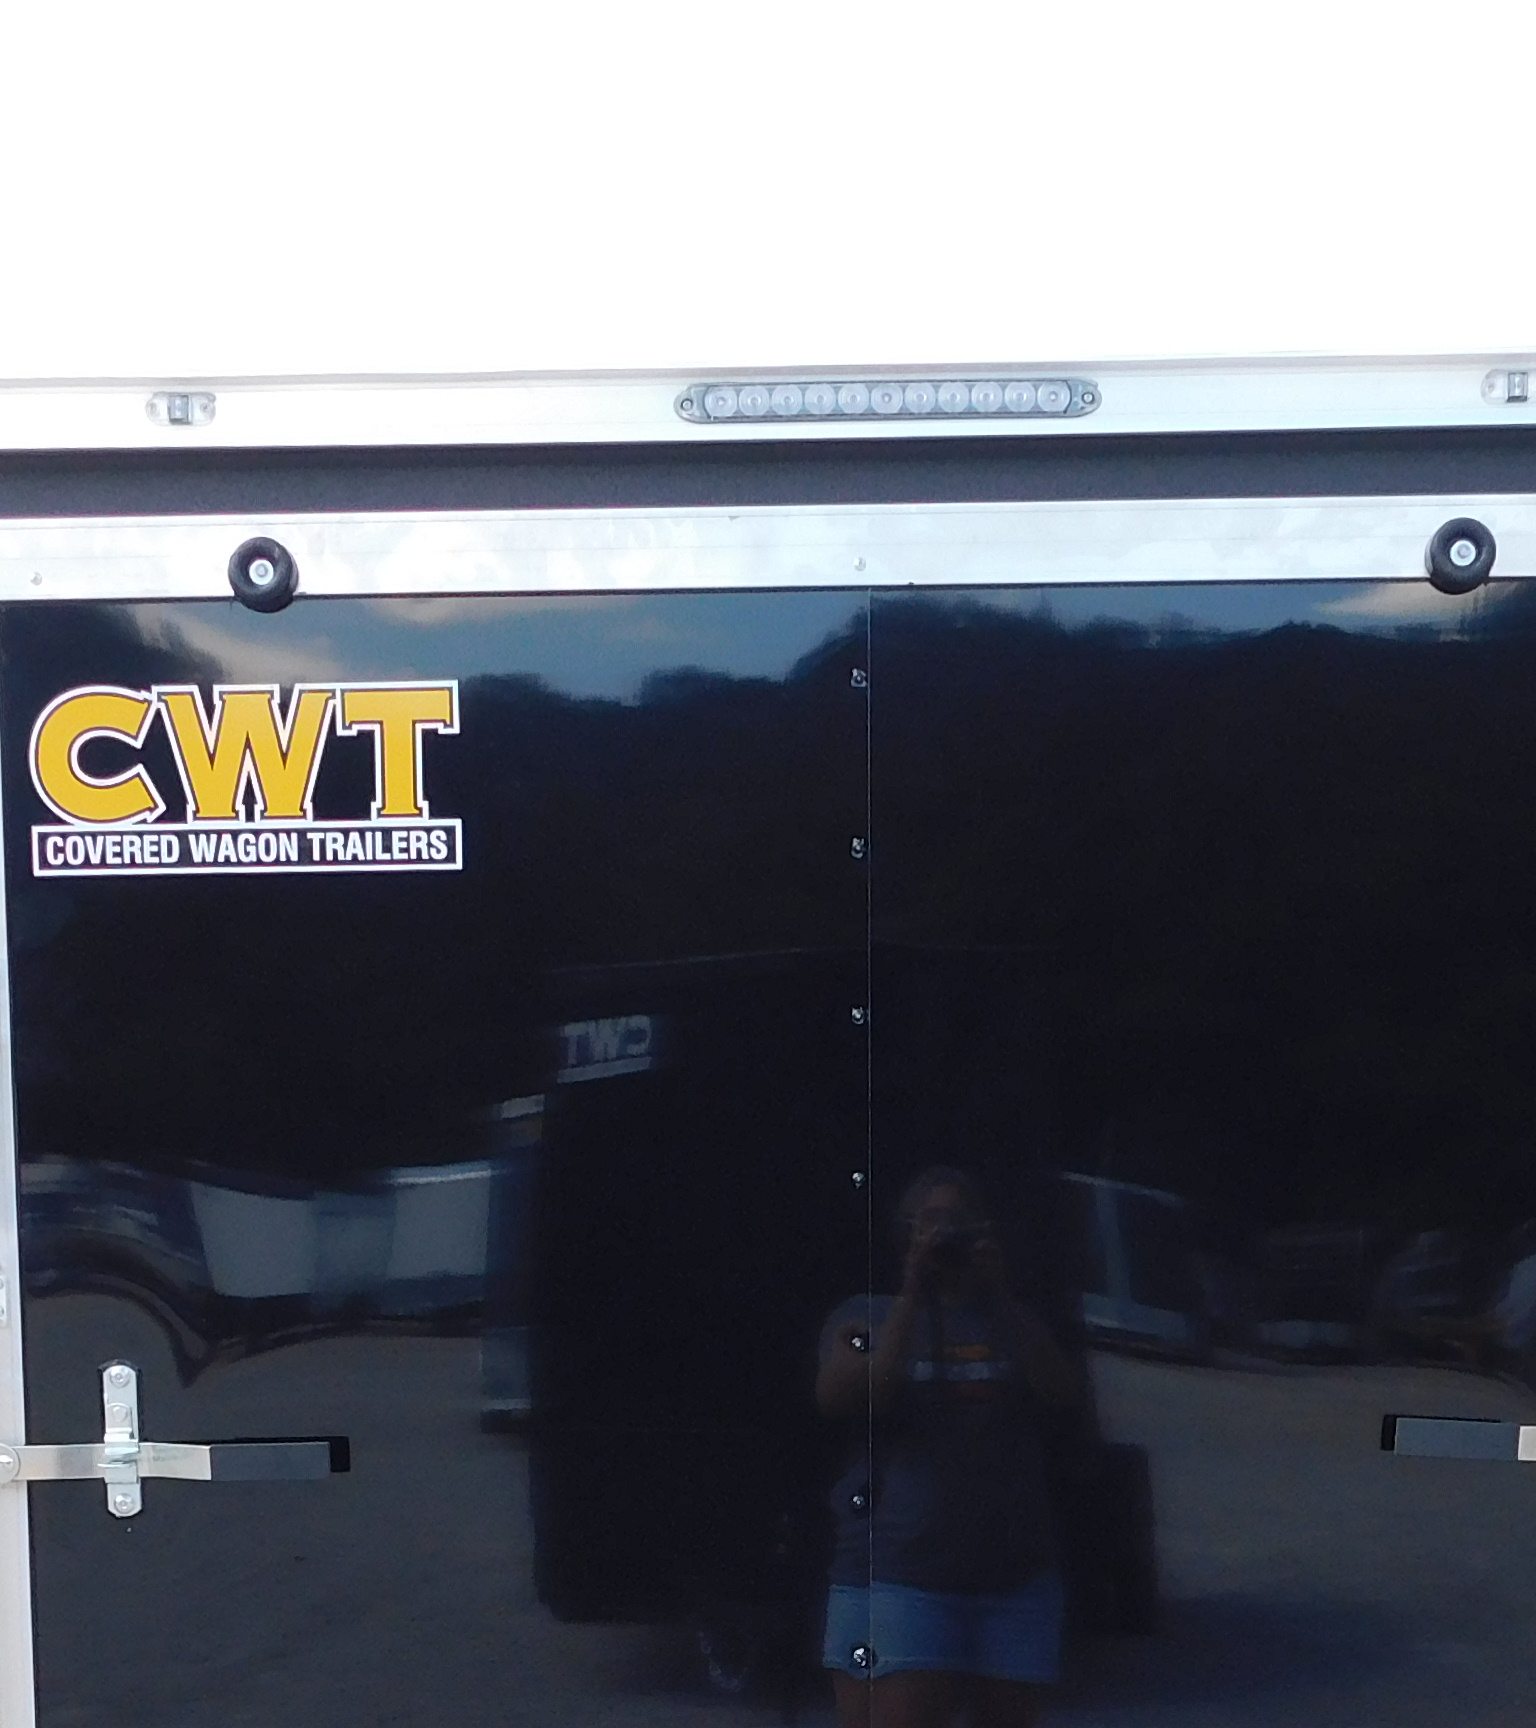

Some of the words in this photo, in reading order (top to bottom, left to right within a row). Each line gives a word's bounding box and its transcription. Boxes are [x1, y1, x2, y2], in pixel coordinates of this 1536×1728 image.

[30, 680, 459, 823] CWT
[45, 832, 181, 866] COVERED
[189, 832, 299, 864] WAGON
[306, 829, 449, 862] TRAILERS
